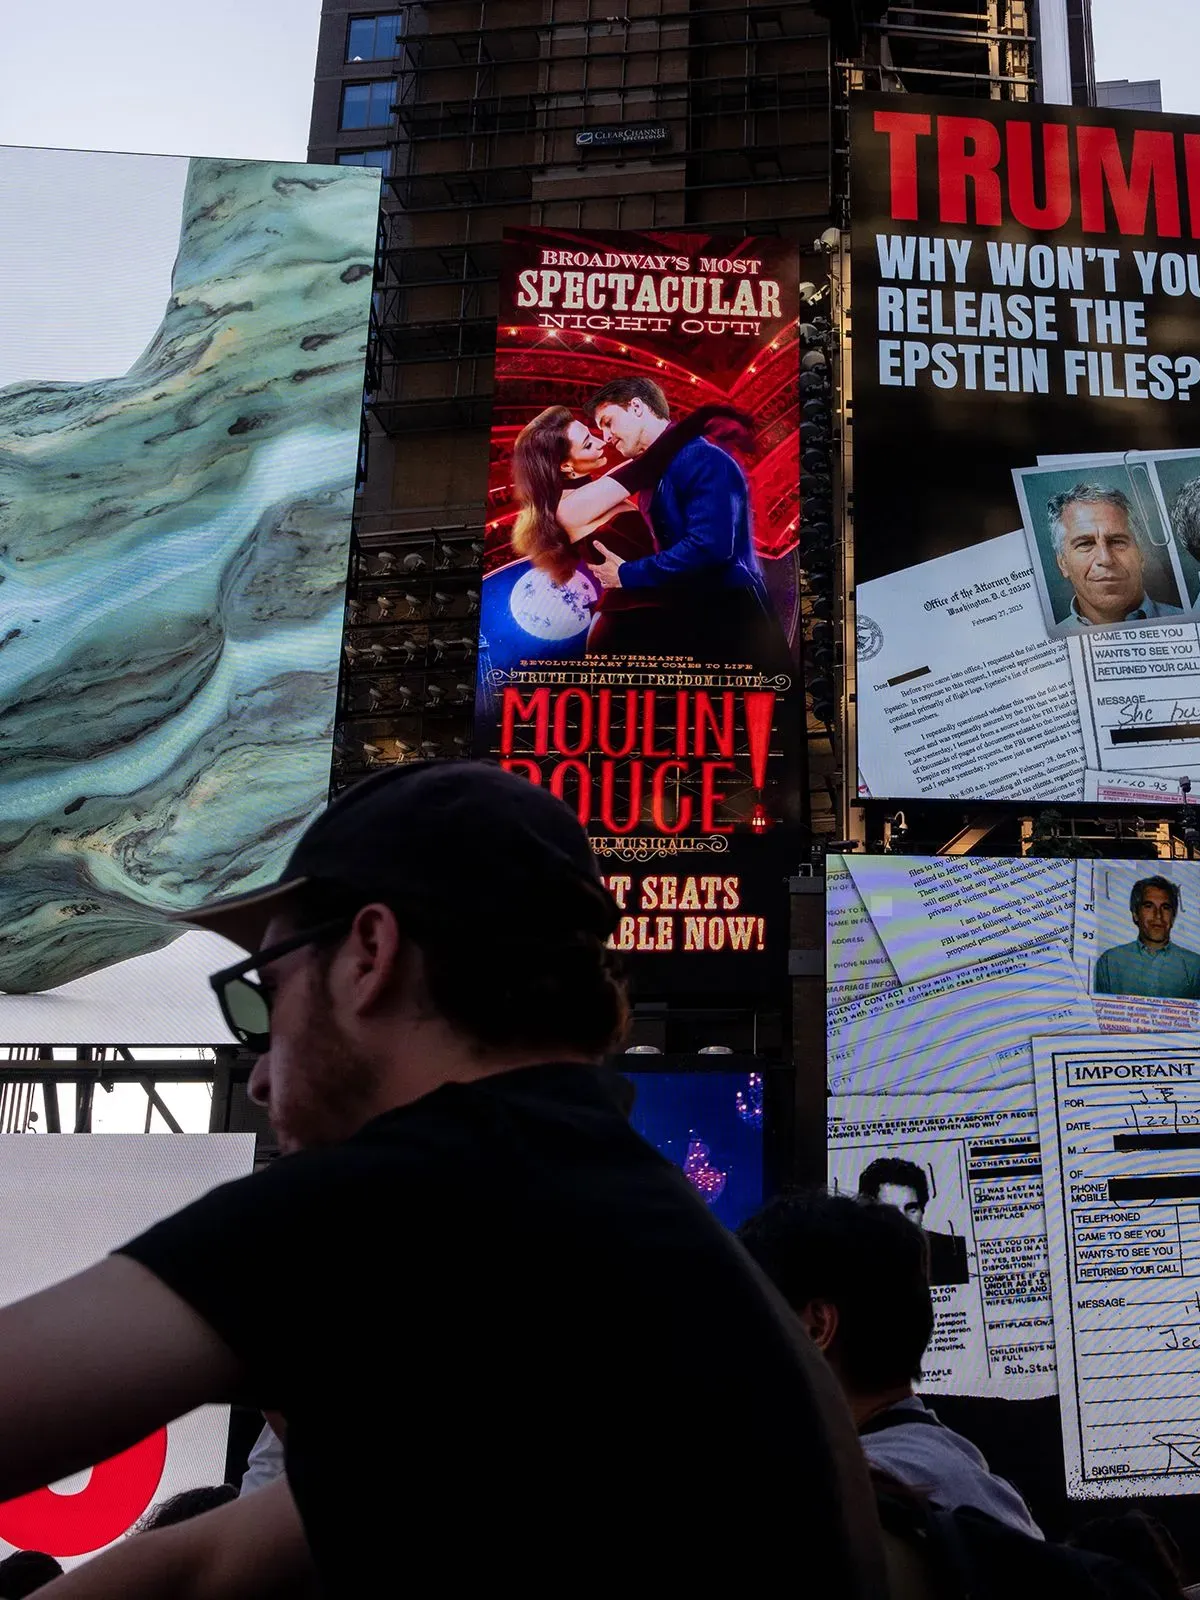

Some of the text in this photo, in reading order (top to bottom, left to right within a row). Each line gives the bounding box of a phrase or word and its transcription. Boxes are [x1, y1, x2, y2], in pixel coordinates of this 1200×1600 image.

[541, 250, 761, 275] BROADWAY'S MOST
[876, 233, 973, 284] WHY
[986, 241, 1120, 293] WON'T
[517, 270, 783, 319] SPECTACULAR
[877, 286, 1148, 346] RELEASE THE
[538, 313, 761, 336] NIGHT OUT!
[878, 339, 1049, 394] EPSTEIN
[923, 597, 949, 612] Office
[950, 591, 958, 603] of
[960, 588, 974, 600] the
[974, 576, 1010, 595] Attorney
[971, 612, 998, 627] February
[1092, 627, 1184, 641] CAME TO SEE YOU
[1095, 644, 1193, 658] WANTS TO SEE YOU
[520, 659, 622, 669] REVOLUTIONARY
[1097, 661, 1200, 676] RETURNED YOUR CALL
[519, 672, 762, 687] TRUTH BEAUTY FREEDOM LOVE
[1097, 694, 1146, 706] MESSAGE
[500, 686, 736, 758] MOULIN
[615, 838, 695, 849] MUSICAL!
[641, 875, 741, 910] SEATS
[684, 916, 765, 950] NOW!
[864, 989, 904, 1007] CONTACT
[1075, 1062, 1195, 1080] IMPORTANT
[1064, 1099, 1085, 1108] FOR
[841, 1124, 859, 1132] YOU
[885, 1121, 907, 1129] BEEN
[909, 1118, 945, 1126] REFUSED
[901, 1125, 937, 1134] EXPLAIN
[1066, 1122, 1091, 1131] DATE
[968, 1137, 1007, 1146] FATHER'S
[1069, 1170, 1084, 1179] OF
[1070, 1183, 1107, 1193] PHONE/
[1071, 1193, 1107, 1202] MOBILE
[1076, 1213, 1140, 1224] TELEPHONED
[1078, 1229, 1166, 1242] CAME TO SEE YOU
[1079, 1247, 1173, 1260] WANTS TO SEE YOU
[1080, 1264, 1179, 1277] RETURNED YOUR CALL
[1077, 1298, 1126, 1309] MESSAGE
[1091, 1465, 1130, 1476] SIGNED
